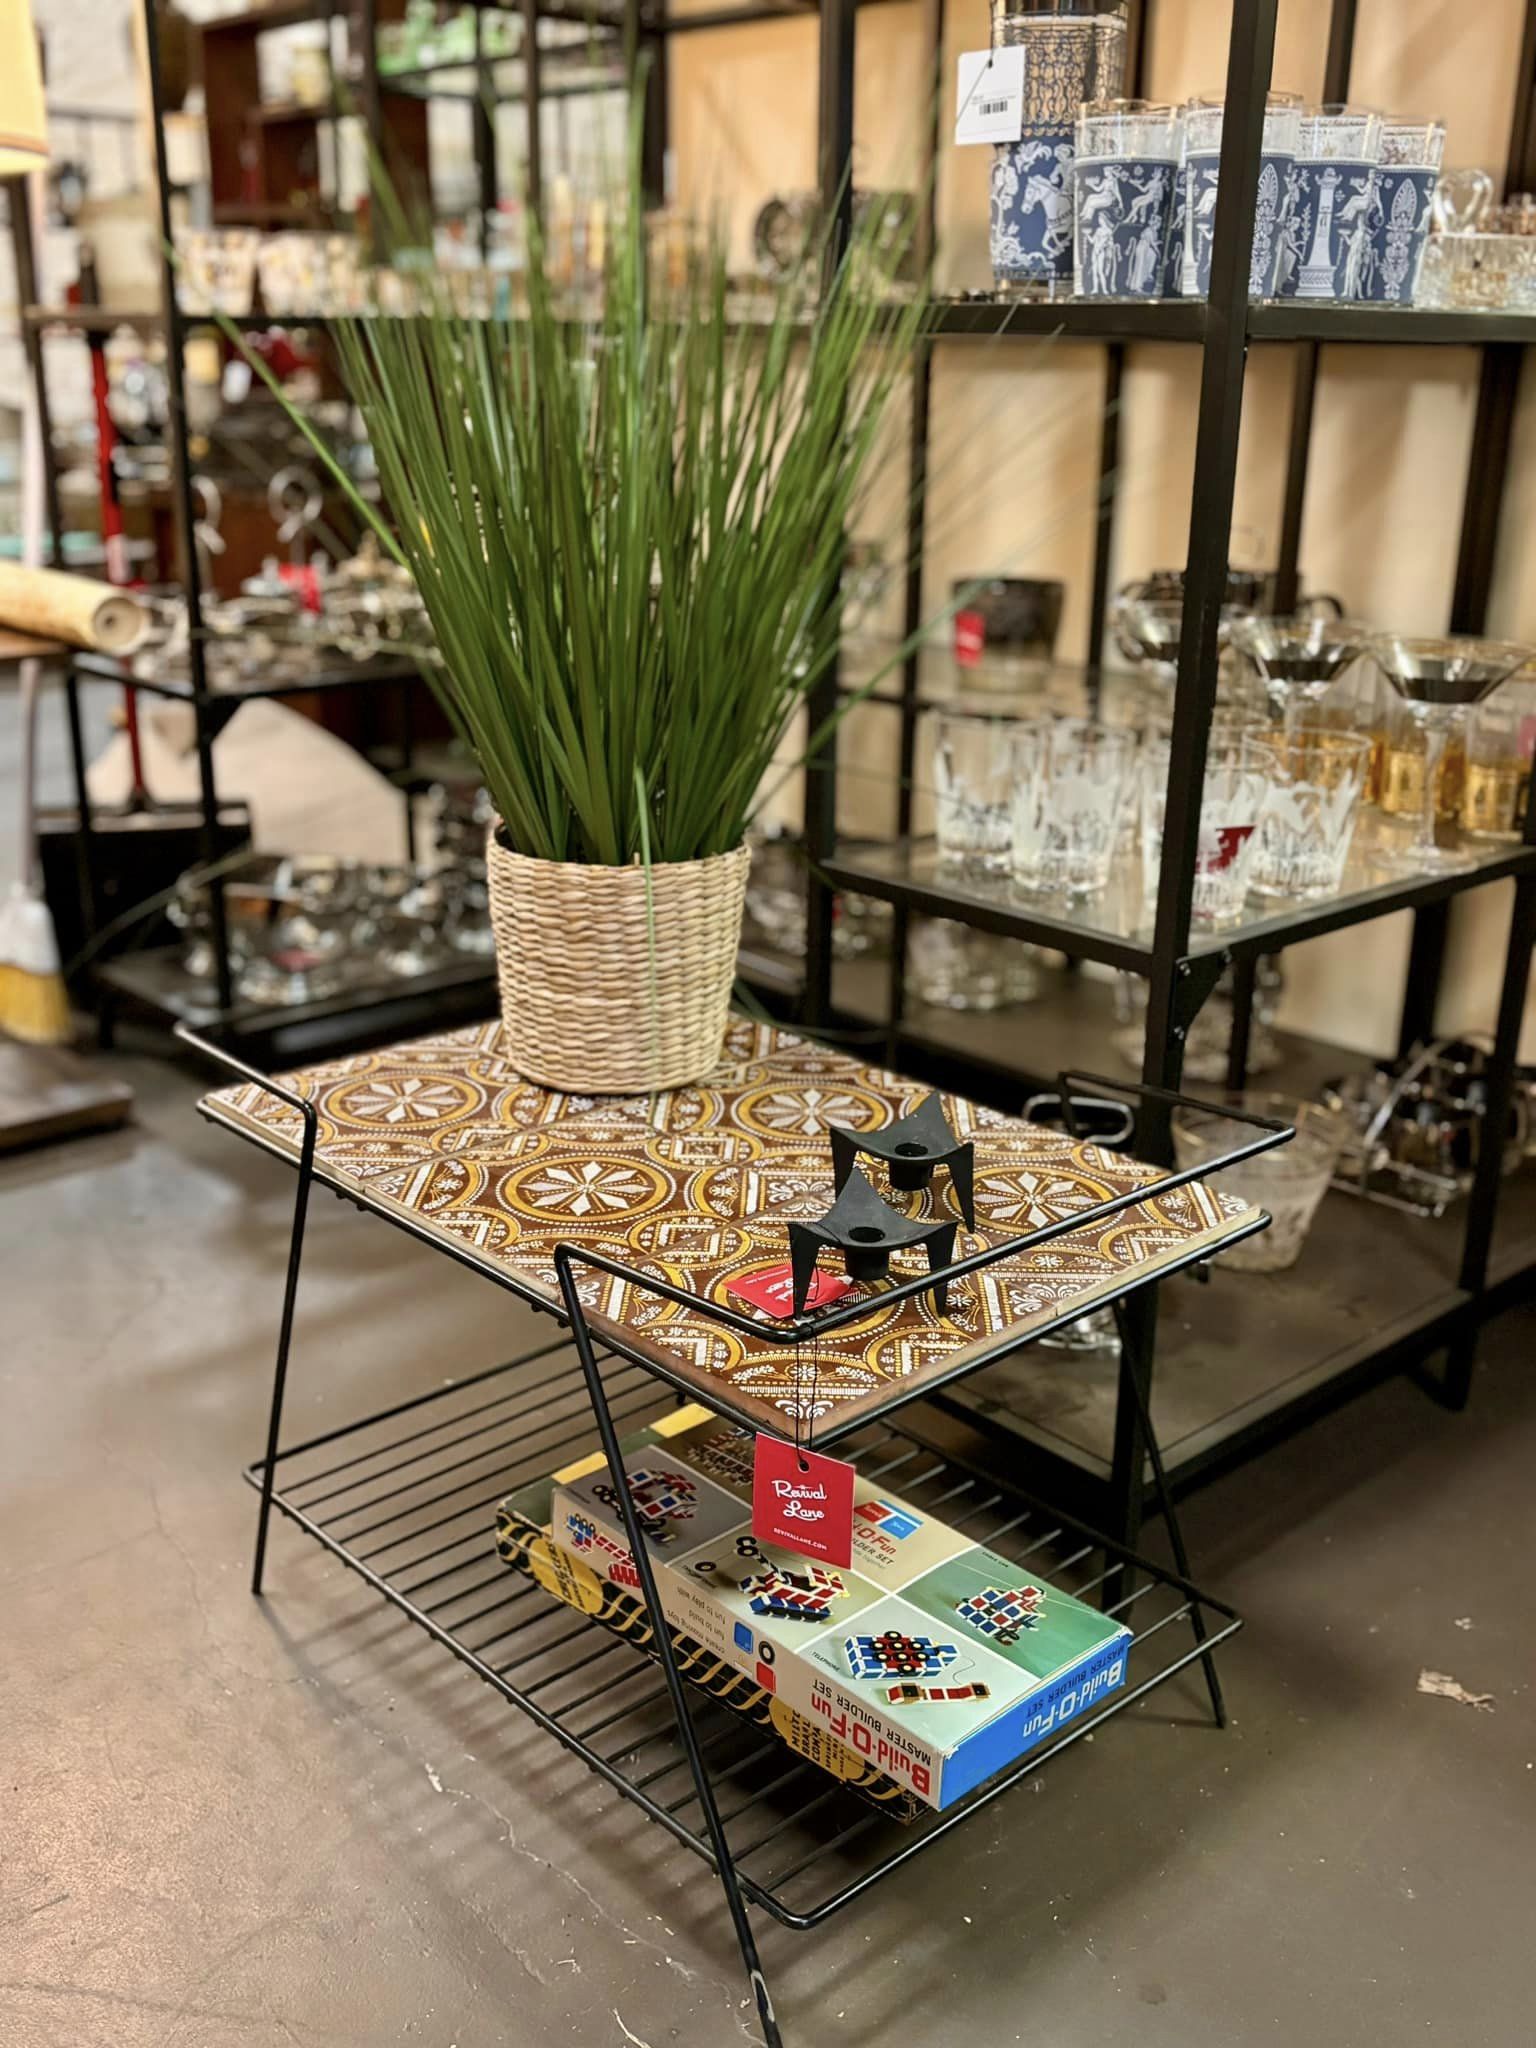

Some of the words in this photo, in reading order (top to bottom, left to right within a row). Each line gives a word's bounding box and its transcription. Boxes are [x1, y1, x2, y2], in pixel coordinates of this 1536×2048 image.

[771, 1480, 827, 1500] Revival
[783, 1500, 824, 1521] Lane
[773, 1527, 828, 1551] REVIVALLANE.COM
[876, 1553, 895, 1566] SET
[690, 1595, 705, 1609] play
[706, 1605, 713, 1616] to
[666, 1609, 681, 1624] toys
[688, 1609, 705, 1626] build
[705, 1621, 713, 1632] to
[811, 1651, 841, 1673] TELEPHONE
[1090, 1643, 1125, 1675] MASTER
[812, 1679, 833, 1697] SET
[1047, 1670, 1087, 1704] BUILDER
[836, 1695, 882, 1732] BUILDER
[1027, 1700, 1043, 1718] SET
[887, 1732, 931, 1767] MASTER
